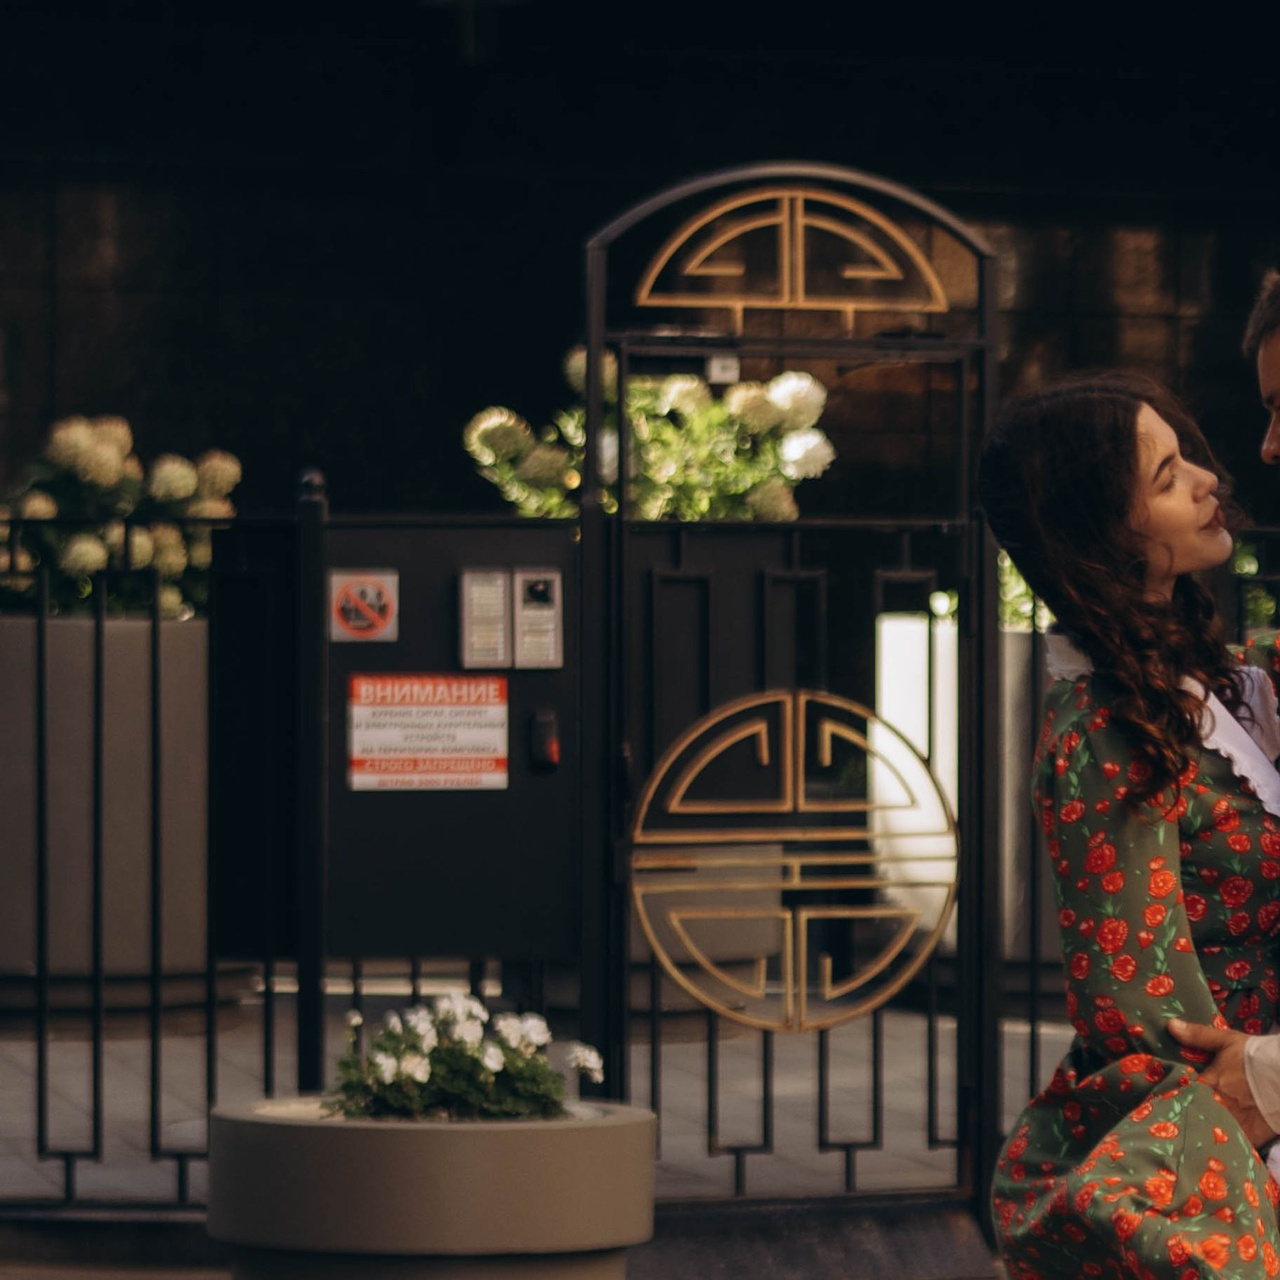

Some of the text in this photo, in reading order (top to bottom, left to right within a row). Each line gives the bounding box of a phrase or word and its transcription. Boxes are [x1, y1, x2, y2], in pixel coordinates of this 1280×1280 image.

[360, 682, 500, 703] ВНИМАНИЕ
[365, 759, 496, 772] СТРОГО ЗАПРЕЩЕНО
